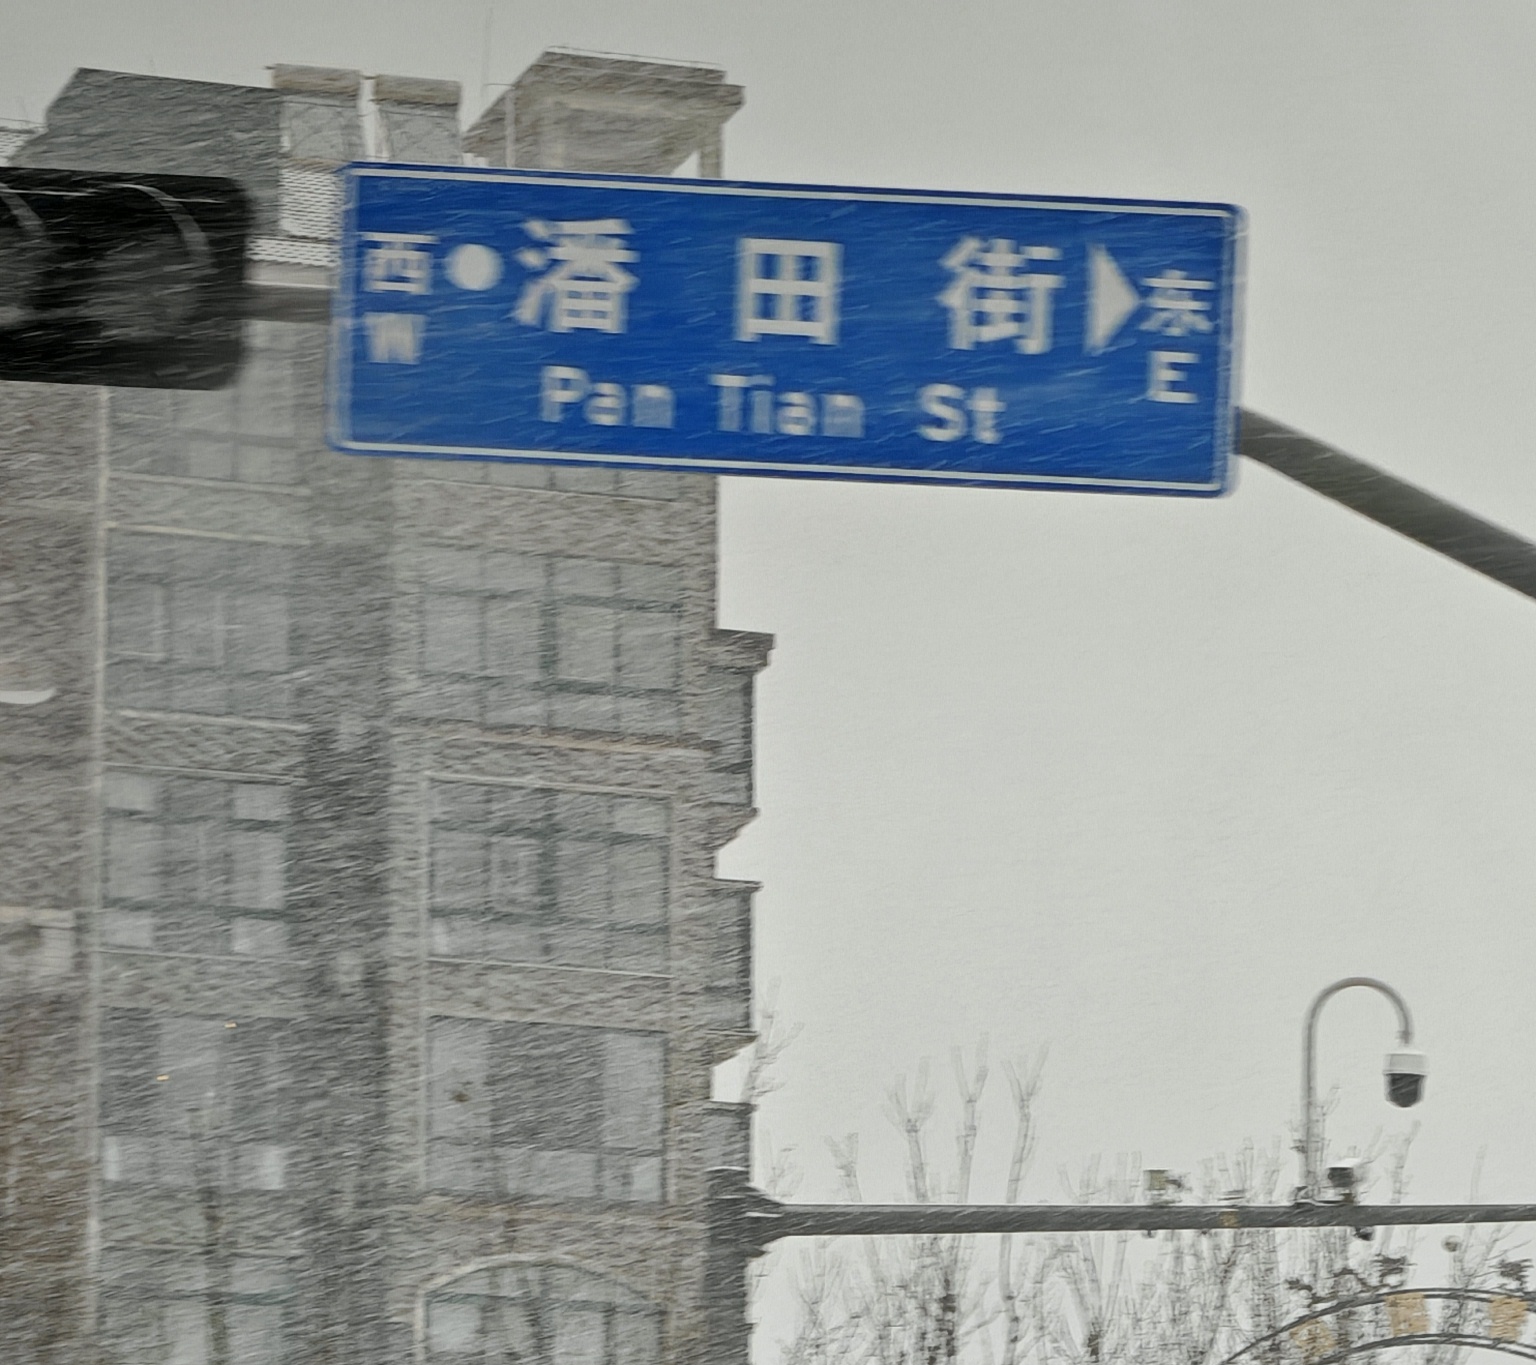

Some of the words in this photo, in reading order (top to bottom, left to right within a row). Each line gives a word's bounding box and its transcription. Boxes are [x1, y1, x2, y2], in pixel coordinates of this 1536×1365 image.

[361, 231, 438, 295] 西
[514, 218, 1066, 354] 潘田街
[1139, 268, 1215, 336] 东
[540, 364, 676, 429] Pan
[708, 373, 866, 438] Tian
[917, 382, 1007, 444] St
[1148, 351, 1200, 403] E
